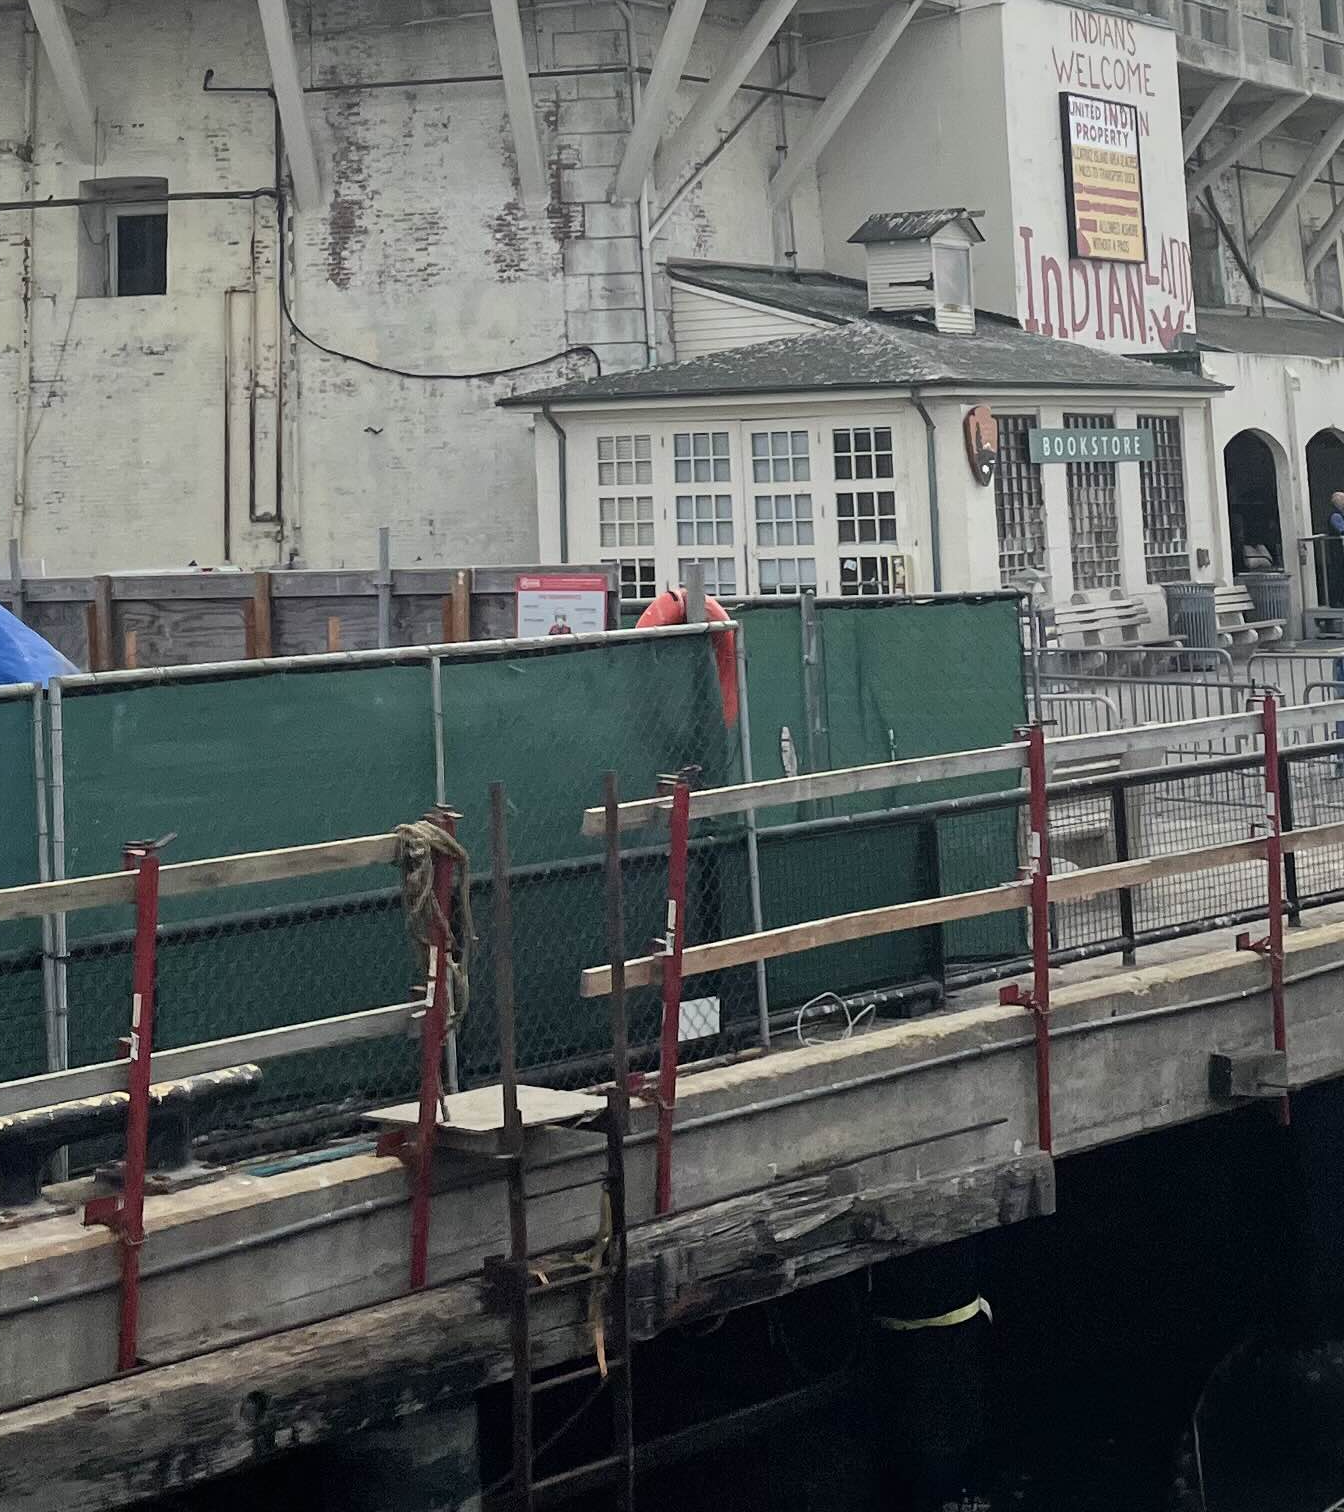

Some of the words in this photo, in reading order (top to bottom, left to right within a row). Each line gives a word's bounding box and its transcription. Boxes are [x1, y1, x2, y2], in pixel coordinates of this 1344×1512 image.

[1069, 9, 1137, 57] INDIANS
[1051, 44, 1156, 97] WELCOME
[1069, 100, 1102, 121] UNITED
[1103, 101, 1150, 137] INDIN
[1076, 121, 1129, 148] PROPERTY
[1042, 436, 1141, 457] BOOKSTORE
